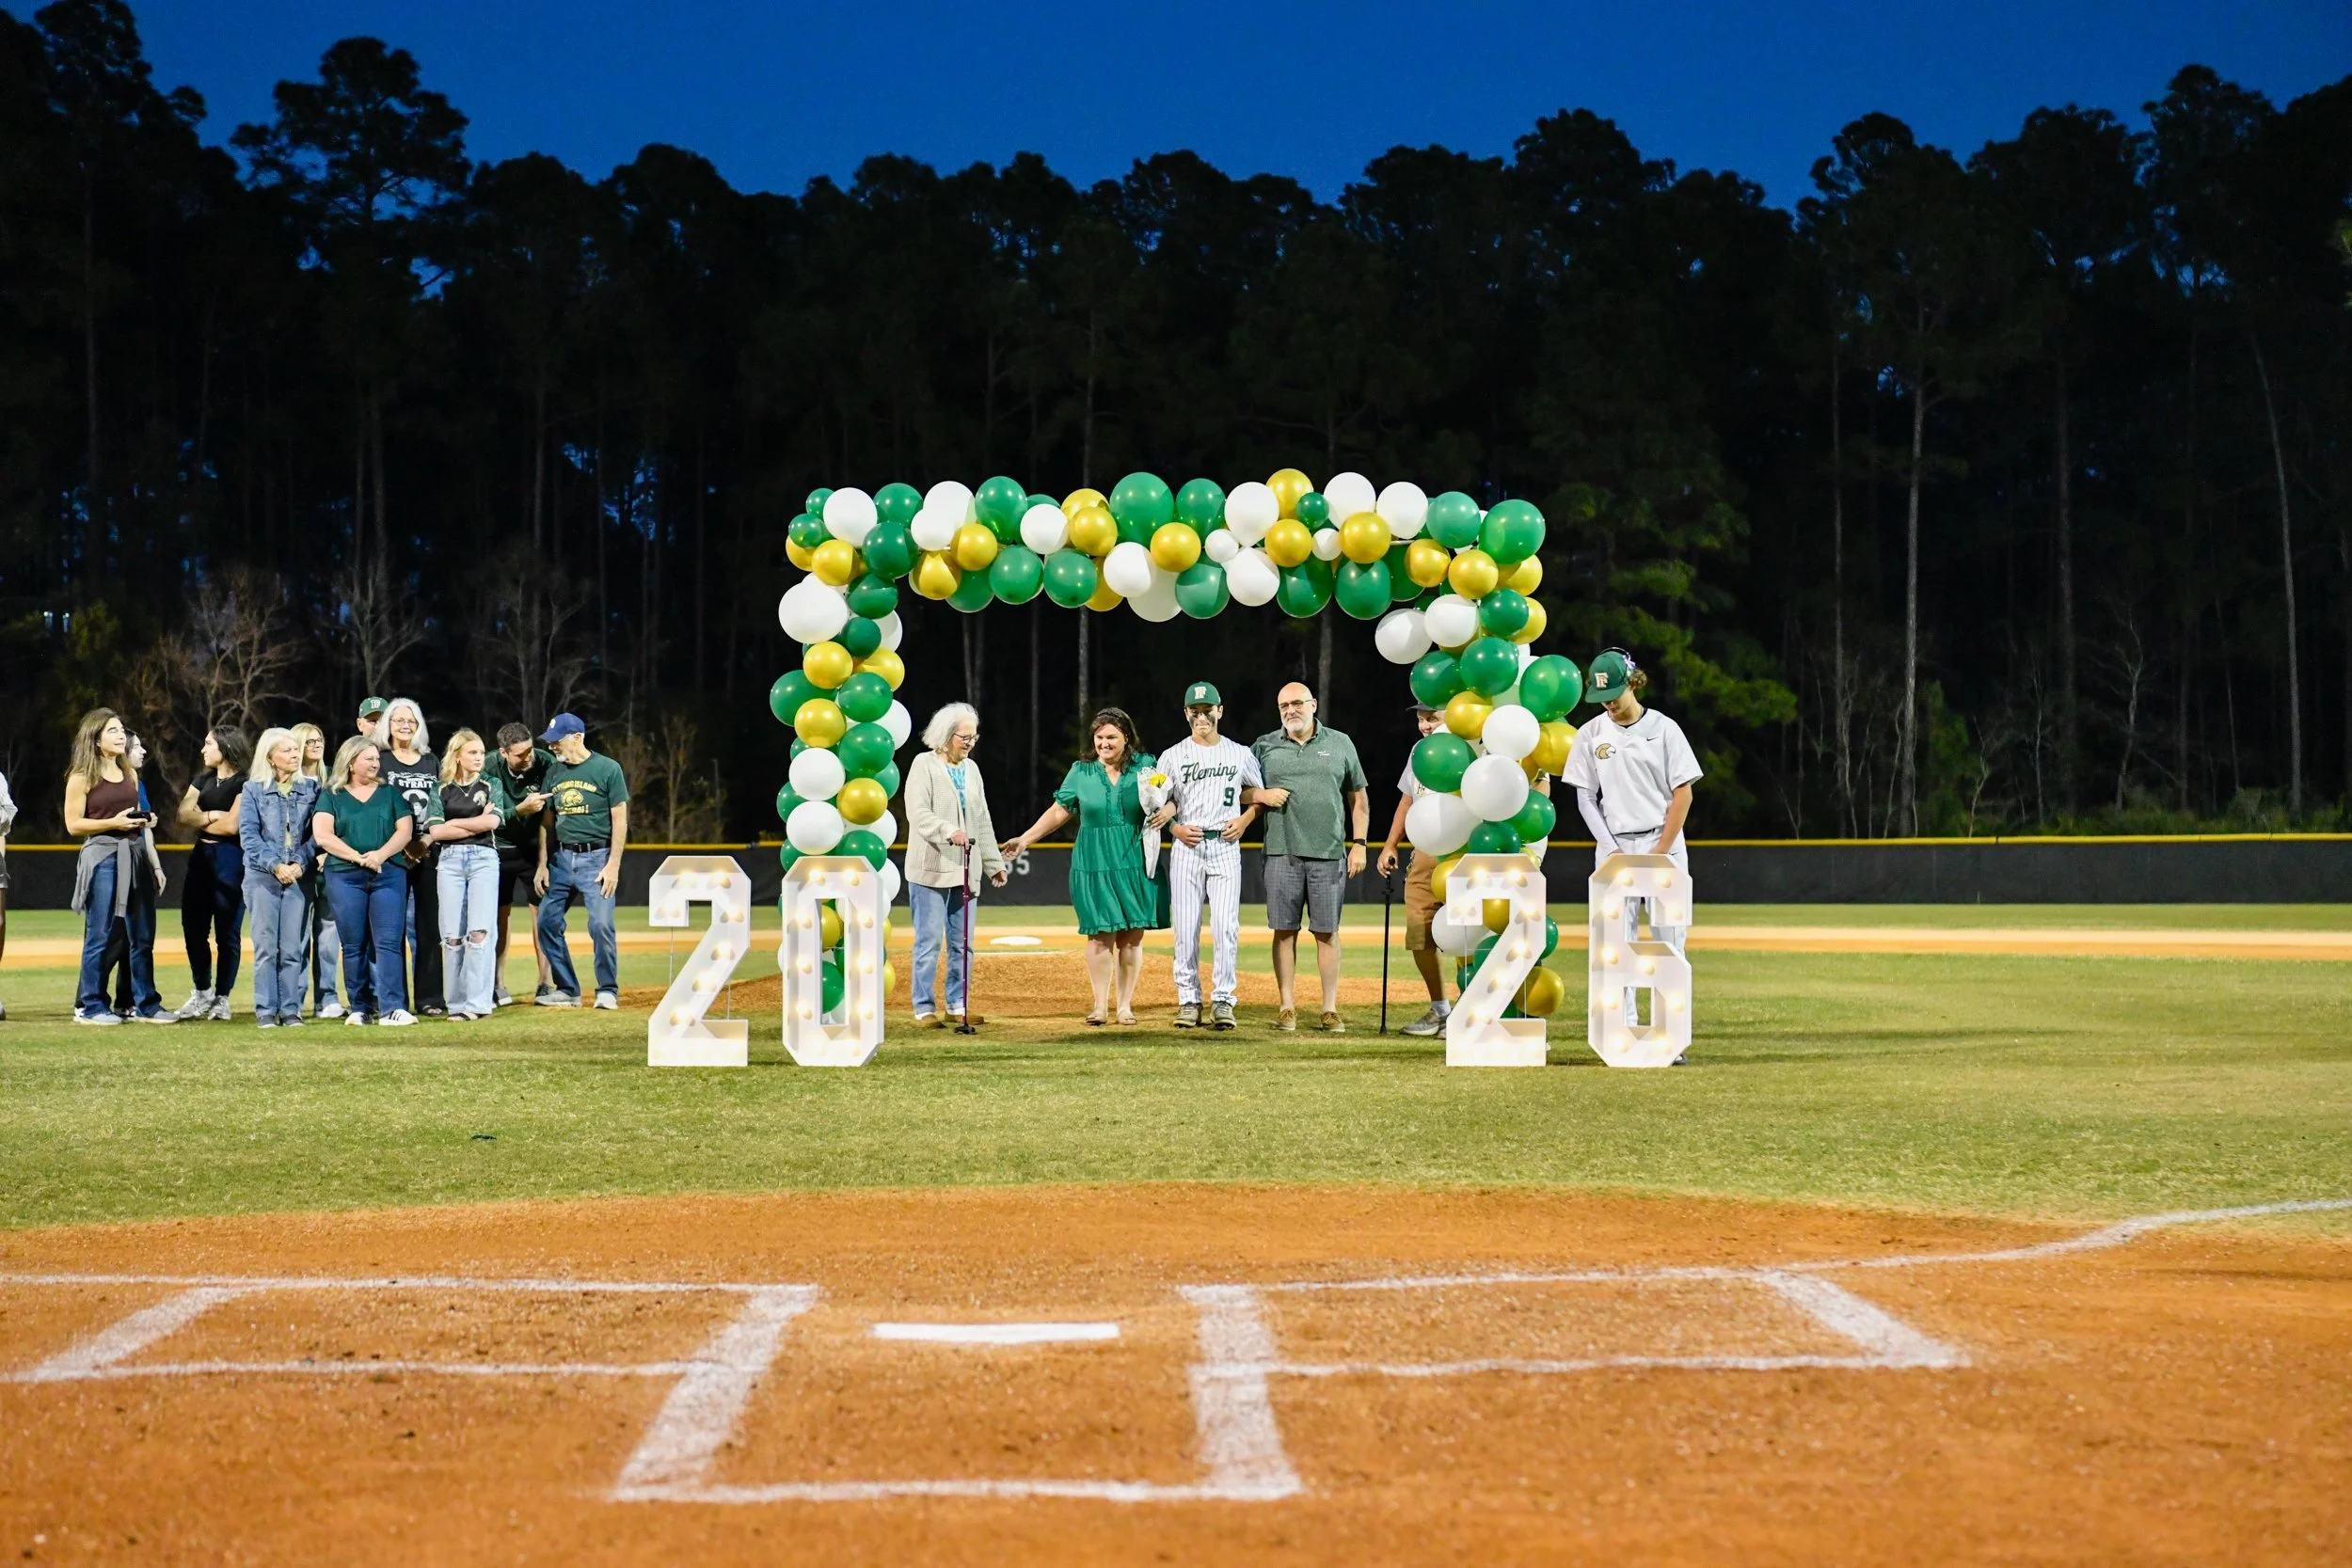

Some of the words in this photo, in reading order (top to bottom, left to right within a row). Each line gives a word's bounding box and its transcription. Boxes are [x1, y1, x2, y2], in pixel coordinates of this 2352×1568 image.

[1180, 762, 1238, 784] Fleming
[398, 779, 434, 789] STRAIT
[1223, 786, 1235, 807] 9
